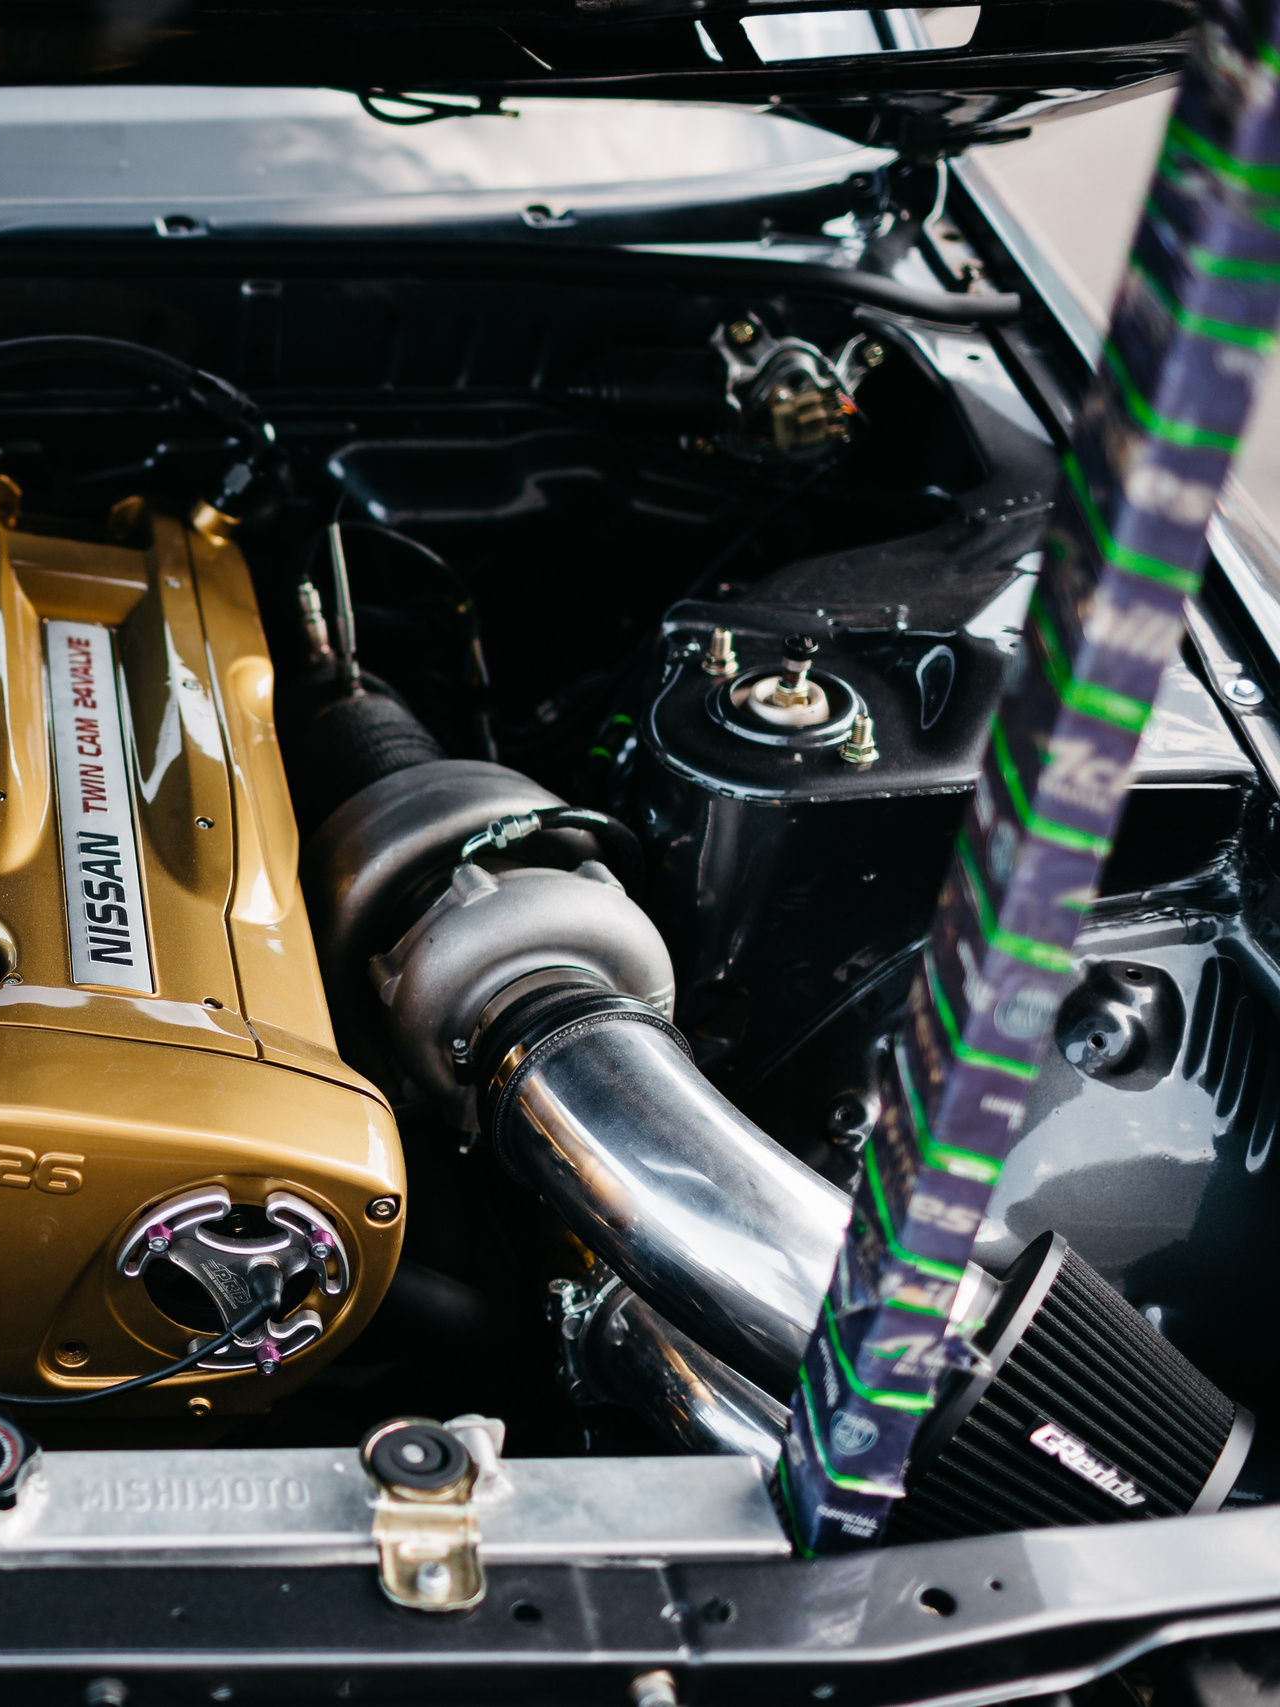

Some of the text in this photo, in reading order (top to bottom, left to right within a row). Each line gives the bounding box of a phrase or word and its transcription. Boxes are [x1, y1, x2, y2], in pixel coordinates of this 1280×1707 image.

[67, 636, 134, 967] NISSAN TWIN CAM 24VALVE
[212, 1268, 249, 1304] PRP
[80, 1476, 311, 1513] MISHIMOTO
